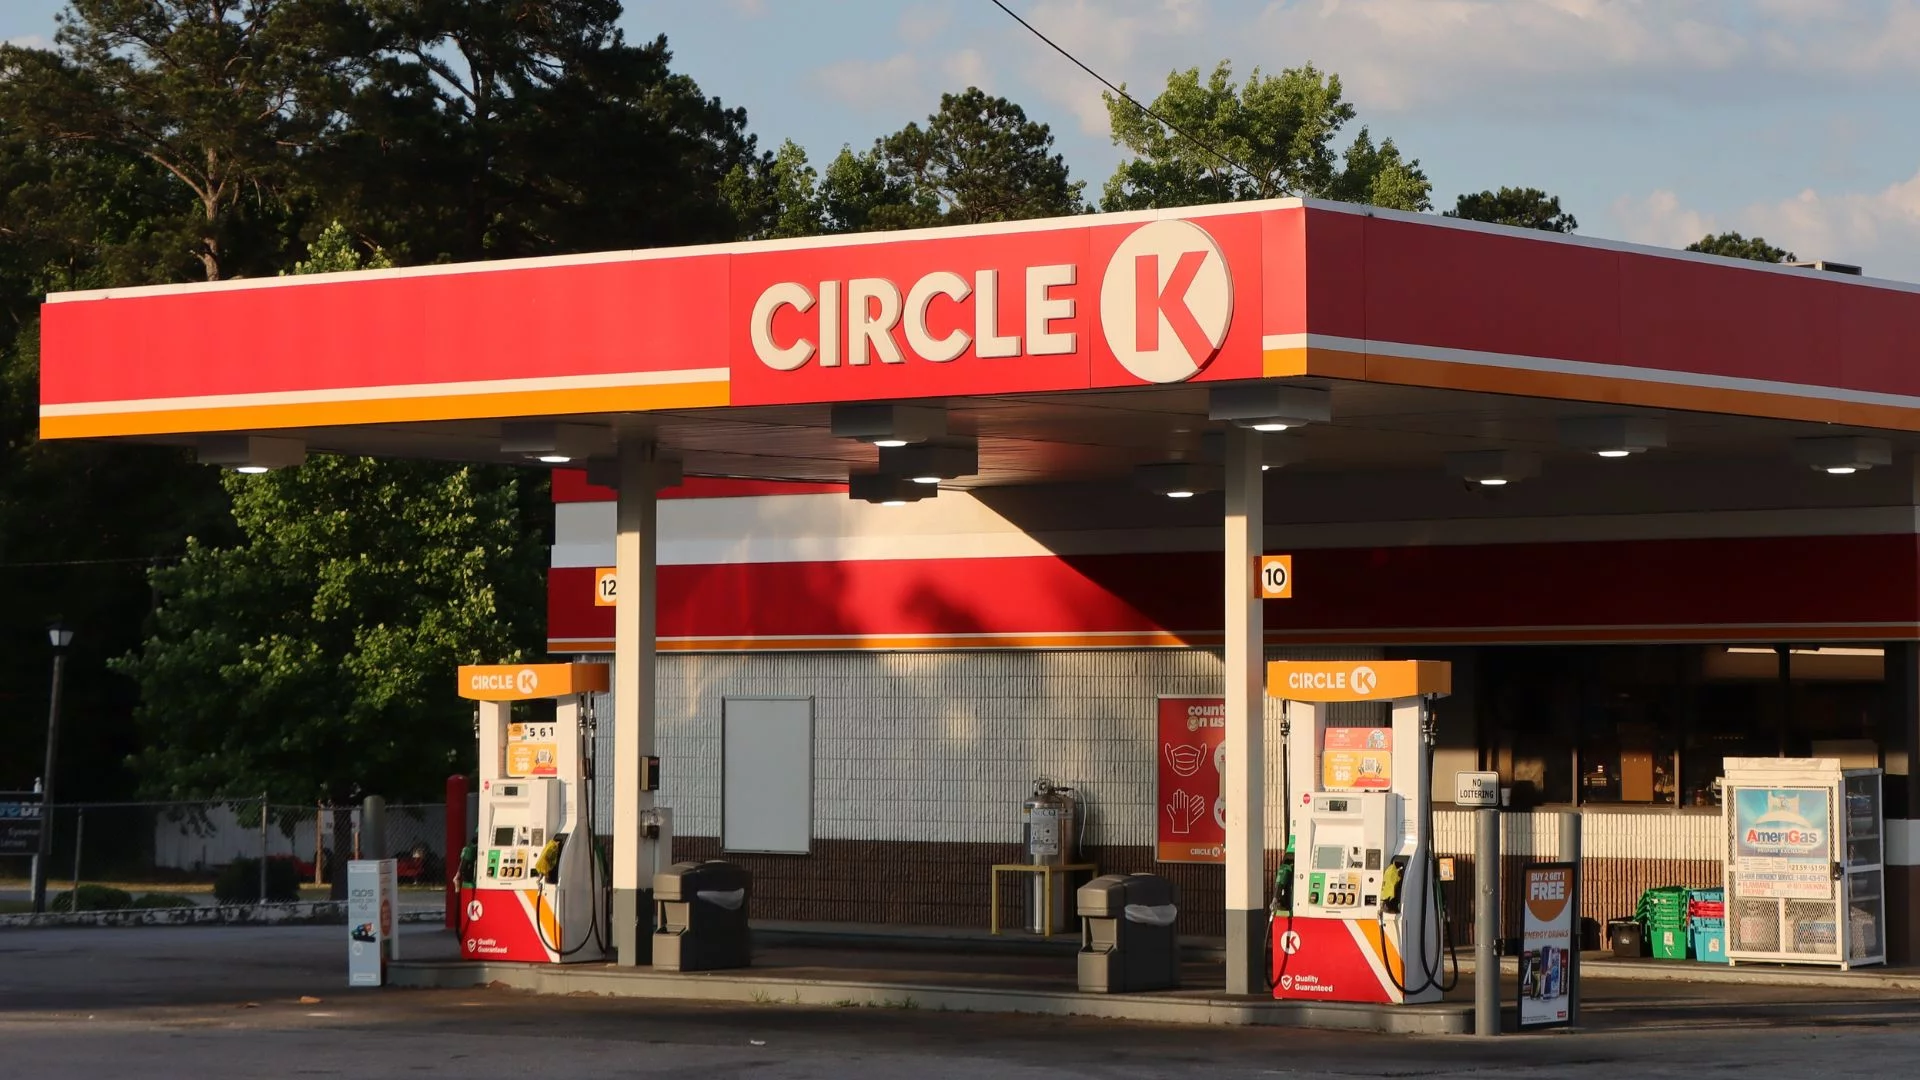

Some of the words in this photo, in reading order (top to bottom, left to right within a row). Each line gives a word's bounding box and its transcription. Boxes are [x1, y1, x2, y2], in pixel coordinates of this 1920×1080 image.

[749, 263, 1078, 371] CIRCLE
[1265, 567, 1286, 587] 10
[601, 579, 617, 596] 12
[471, 674, 514, 690] CIRCLE
[1288, 671, 1346, 689] CIRCLE
[1187, 703, 1225, 716] count
[1210, 717, 1225, 728] us
[1472, 778, 1482, 787] NO
[1460, 790, 1494, 799] LOITERING
[1746, 829, 1818, 845] AmeriGas
[1531, 872, 1544, 881] BUY
[1544, 872, 1549, 881] 2
[1549, 872, 1561, 881] GET
[1561, 872, 1565, 880] 1
[351, 888, 374, 897] IQOS
[1530, 881, 1565, 901] FREE
[477, 938, 497, 947] Quality
[1294, 974, 1319, 984] Quality
[1294, 983, 1334, 992] Guaranteed
